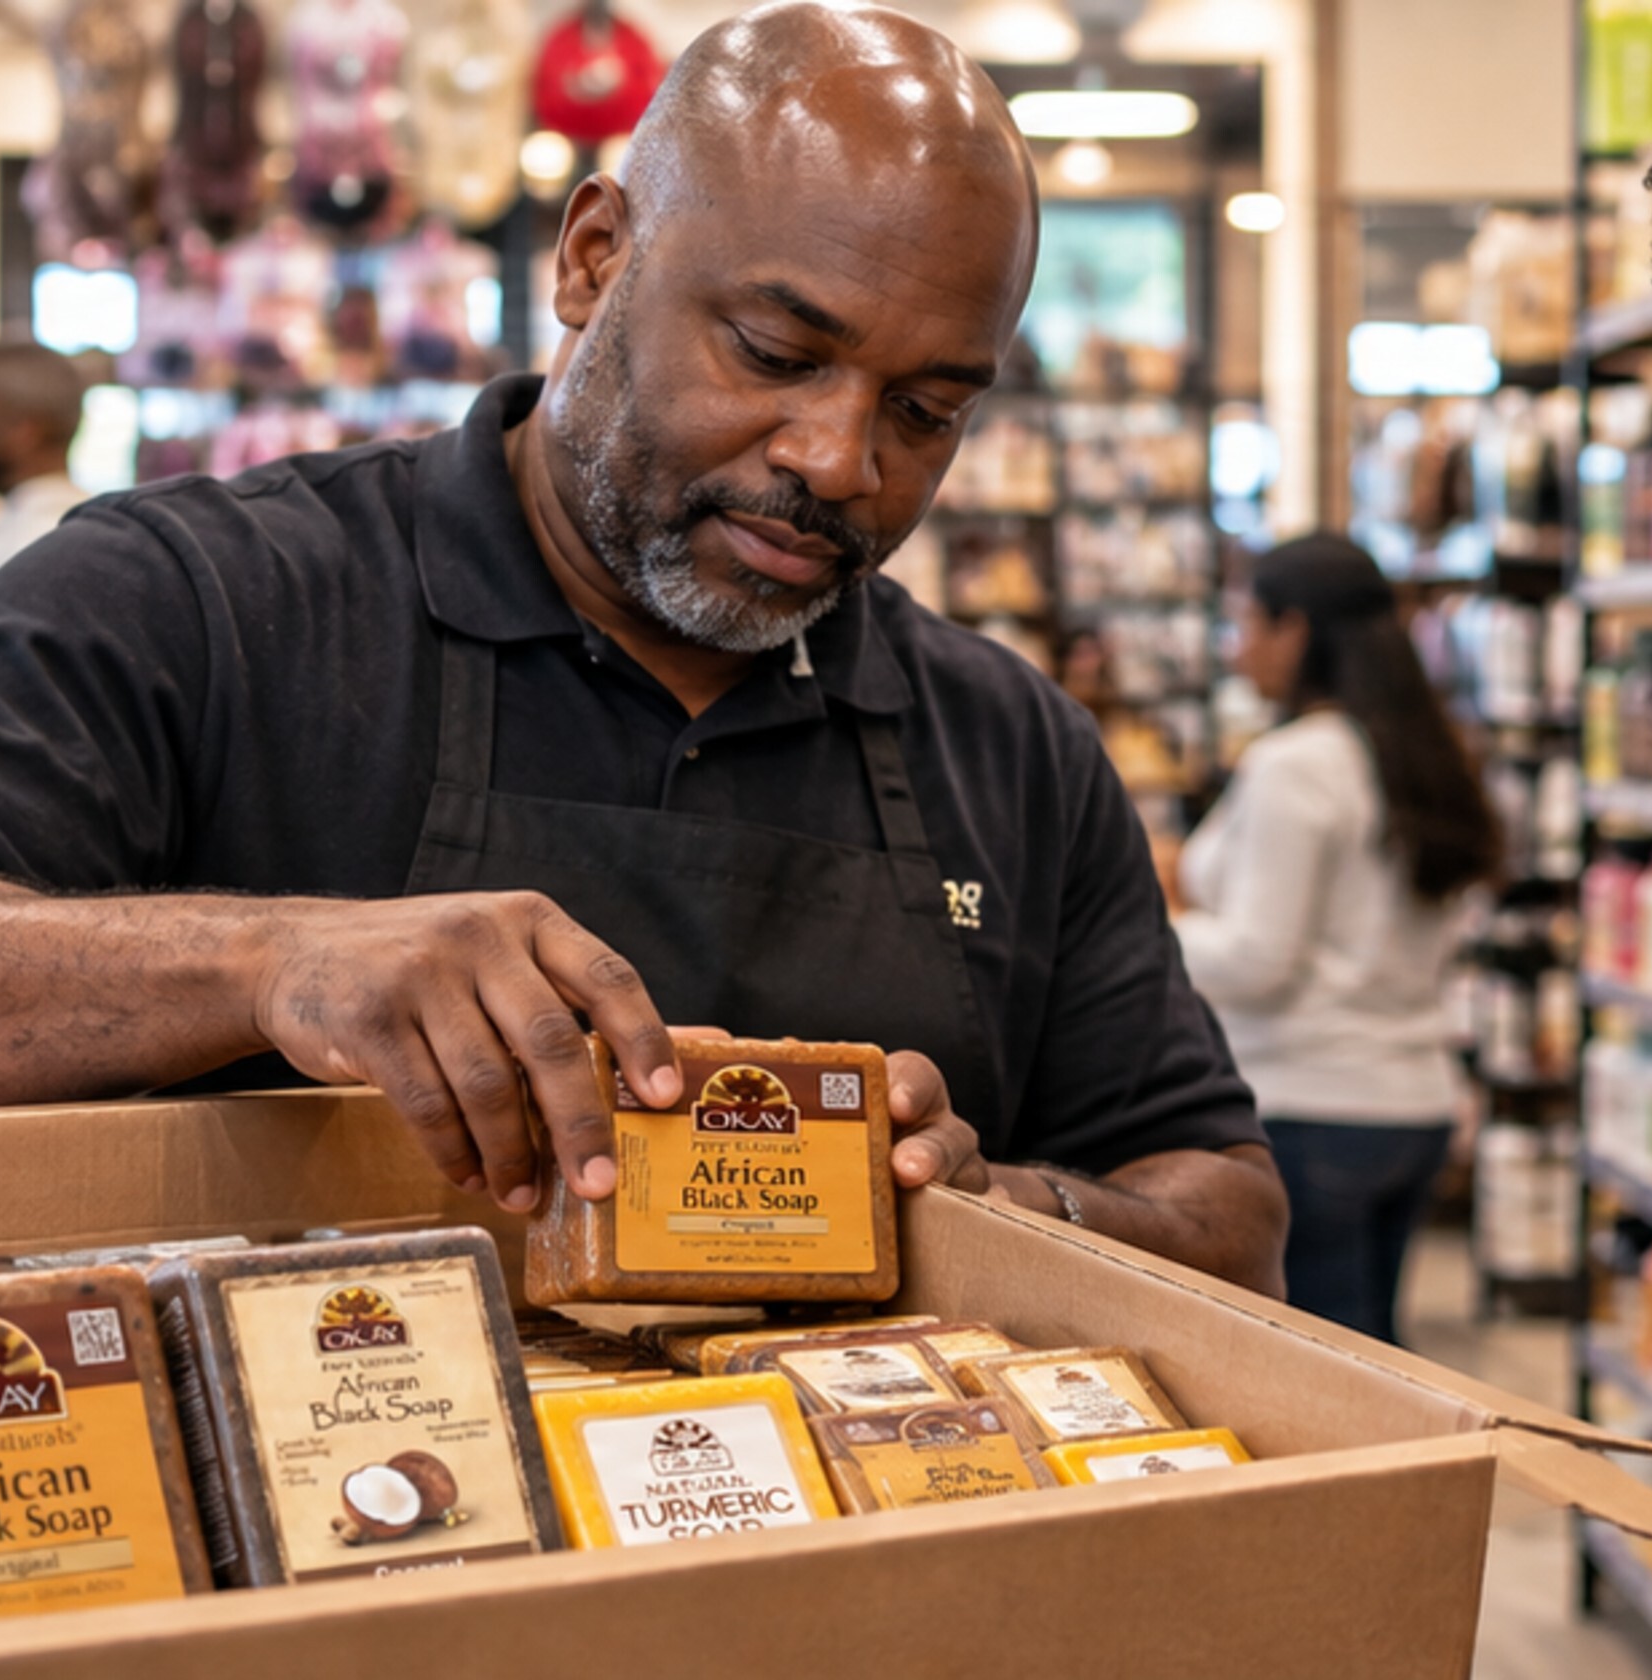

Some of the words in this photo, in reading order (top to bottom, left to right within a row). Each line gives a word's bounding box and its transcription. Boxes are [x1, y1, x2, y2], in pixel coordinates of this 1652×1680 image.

[703, 1111, 788, 1130] OKAY
[690, 1158, 806, 1185] African
[682, 1187, 749, 1209] Black
[760, 1189, 818, 1214] Soap
[334, 1373, 421, 1405] African
[310, 1394, 381, 1431] Black
[386, 1394, 454, 1423] Soap
[26, 1502, 113, 1538] Soap
[621, 1486, 795, 1530] TURMERIC
